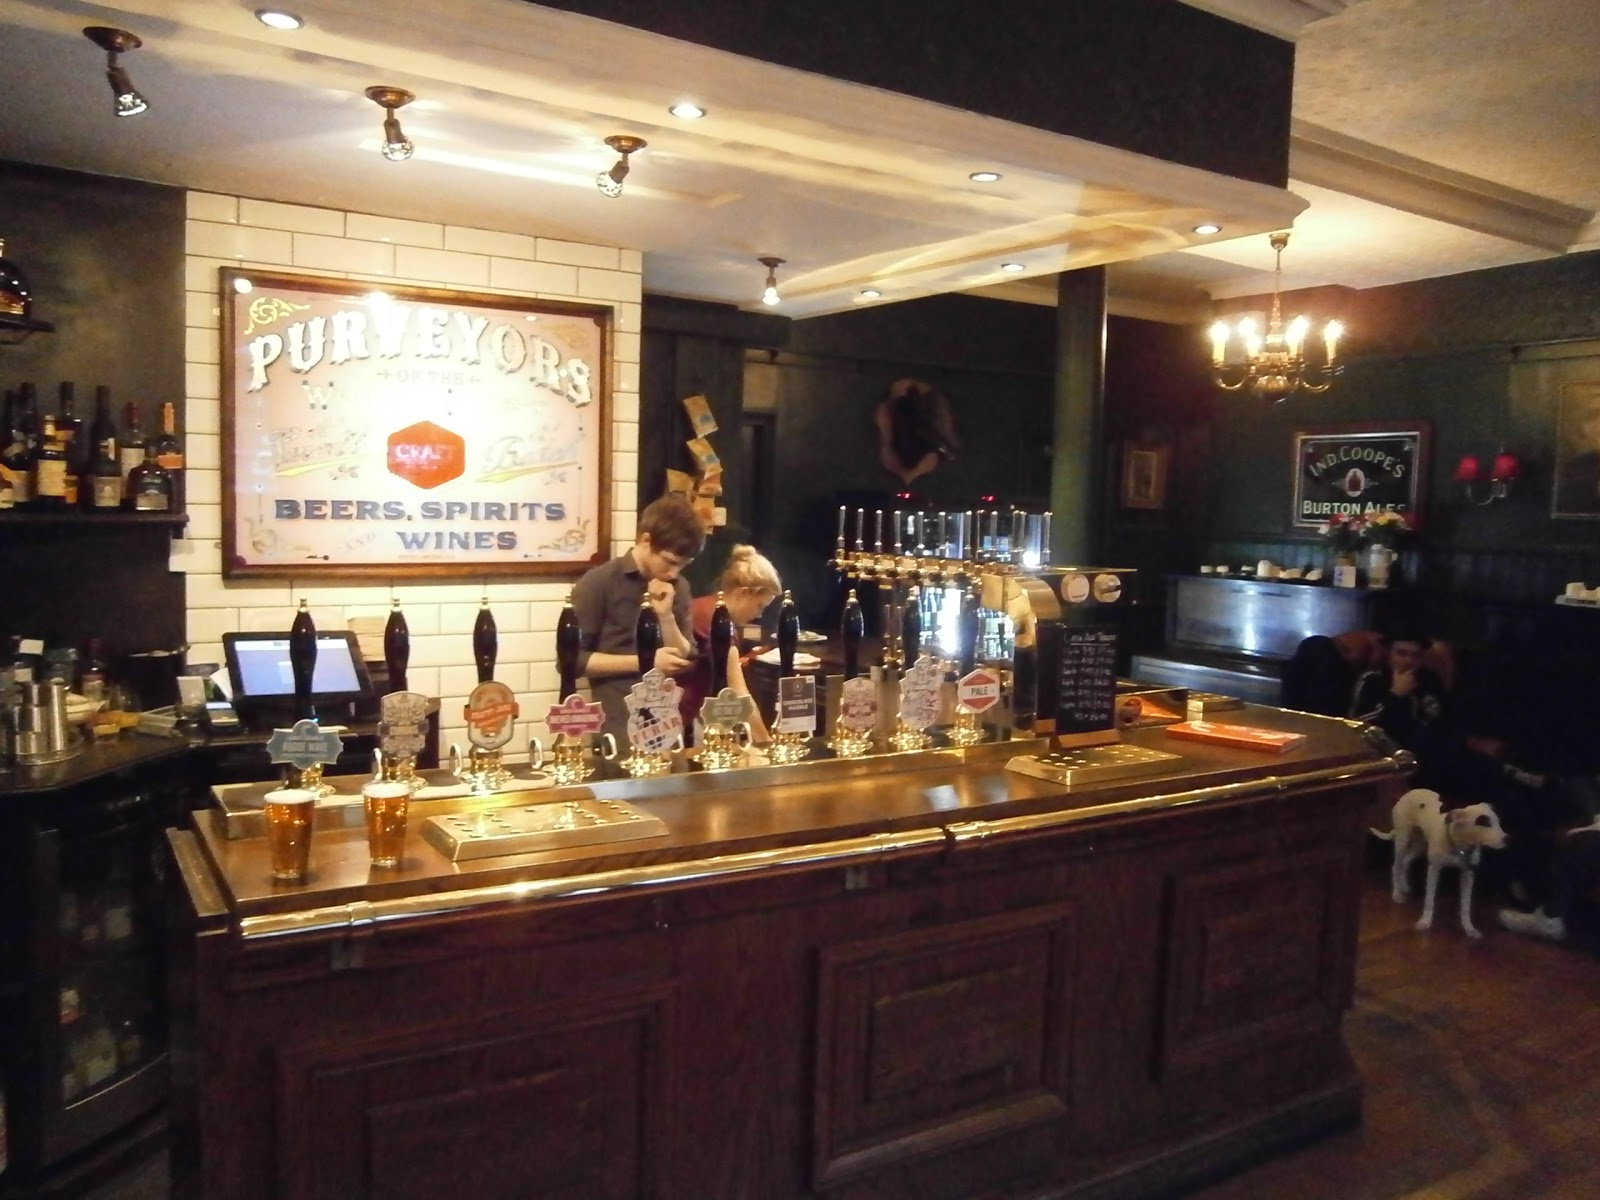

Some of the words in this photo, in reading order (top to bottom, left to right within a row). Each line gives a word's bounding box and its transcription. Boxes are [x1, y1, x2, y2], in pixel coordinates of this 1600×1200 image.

[247, 303, 592, 408] PURVEYORS
[396, 370, 421, 383] OF
[429, 371, 465, 386] THE
[421, 500, 566, 522] SPIRITS
[1303, 499, 1361, 515] BURTON
[396, 531, 518, 551] WINES
[971, 686, 988, 696] PALE
